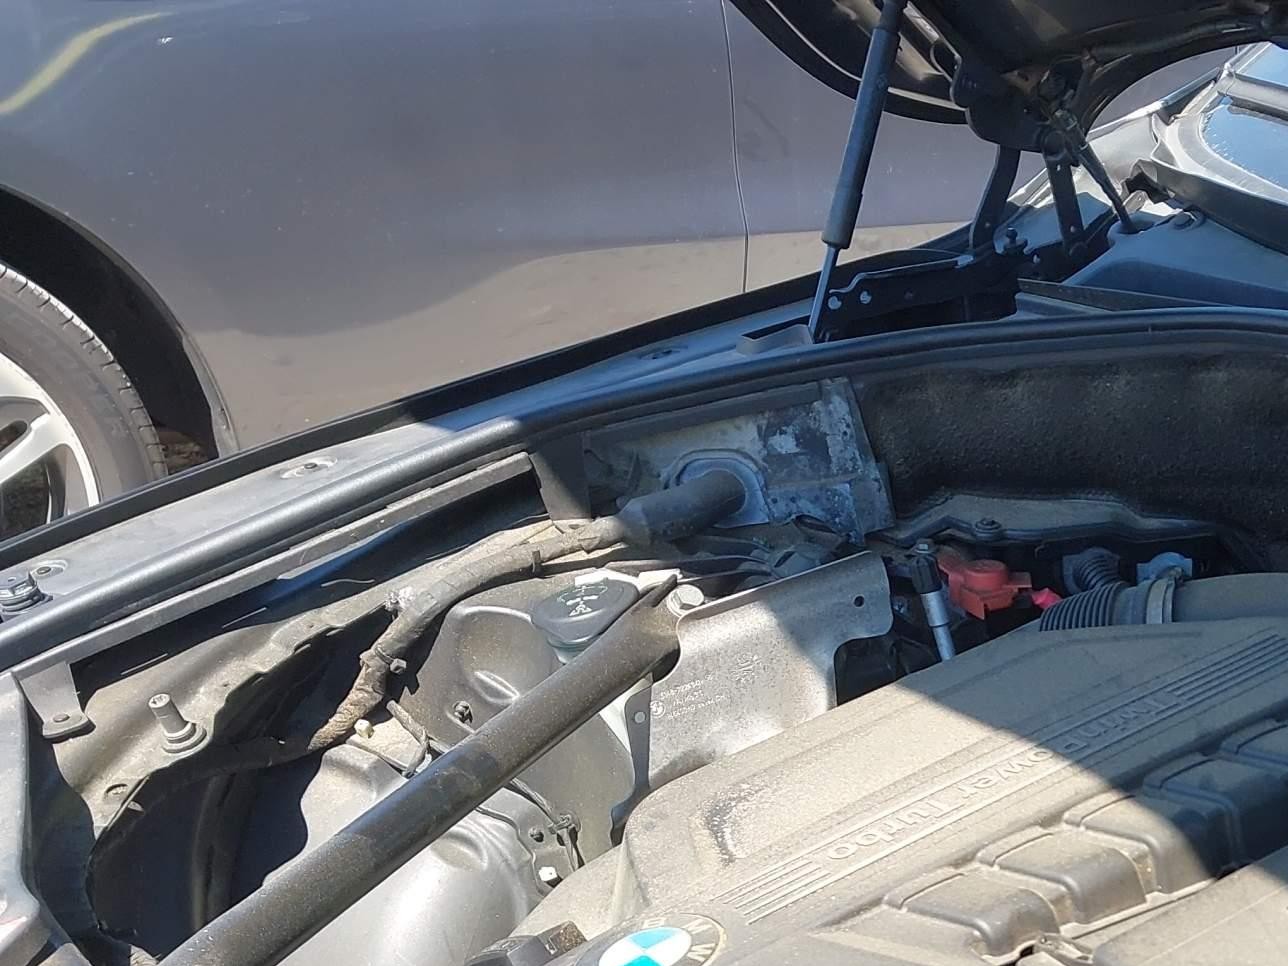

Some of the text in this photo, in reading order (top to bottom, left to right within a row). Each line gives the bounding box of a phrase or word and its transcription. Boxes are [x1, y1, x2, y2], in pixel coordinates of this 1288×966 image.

[826, 693, 1182, 861] TwinPower Turbo
[641, 916, 717, 963] BMW
